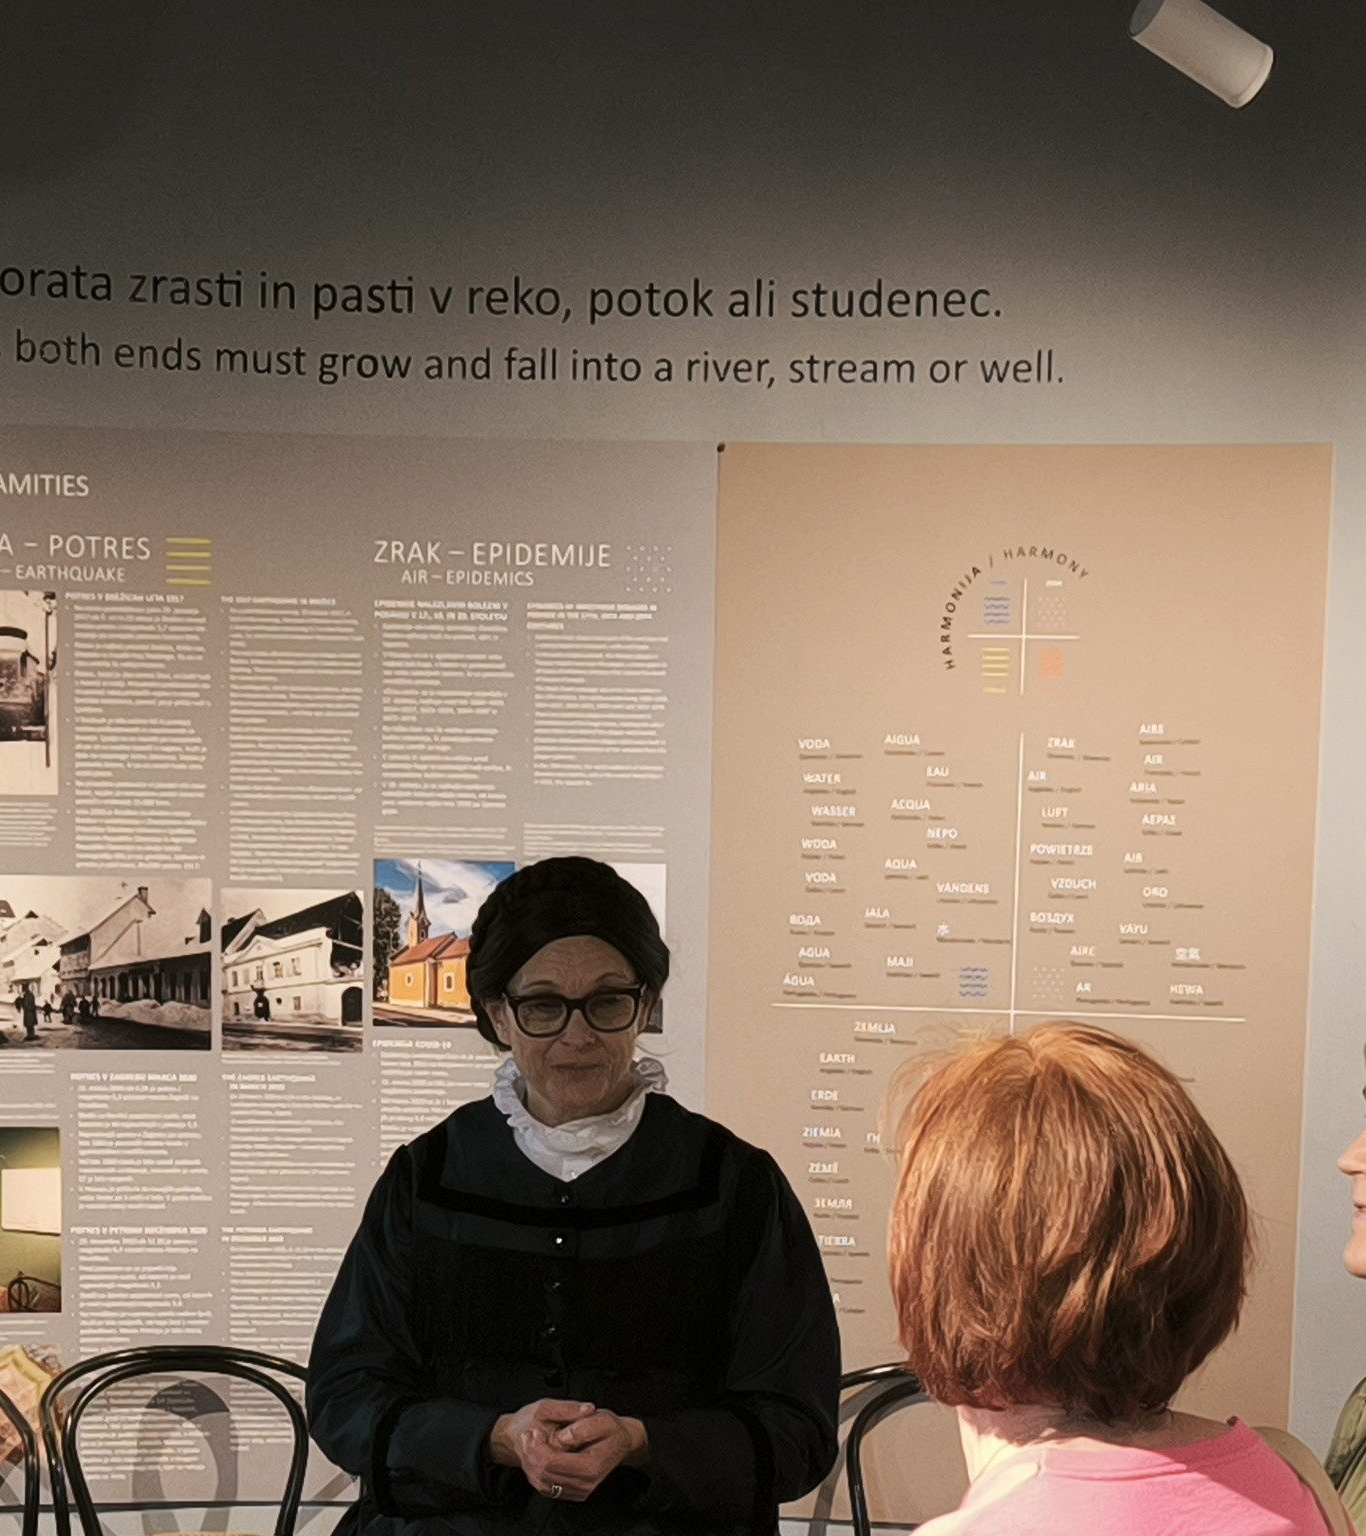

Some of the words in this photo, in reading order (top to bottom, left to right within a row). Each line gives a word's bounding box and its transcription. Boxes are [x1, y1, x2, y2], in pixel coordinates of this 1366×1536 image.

[128, 270, 242, 308] zrasti
[260, 271, 295, 310] in
[314, 275, 413, 321] pasti
[429, 286, 453, 314] v
[468, 275, 571, 323] reko,
[590, 277, 714, 326] potok
[728, 278, 775, 318] ali
[791, 278, 1001, 318] studenec.
[16, 328, 100, 366] both
[114, 337, 201, 371] ends
[216, 346, 307, 376] must
[318, 353, 412, 385] grow
[424, 347, 491, 380] and
[504, 346, 557, 381] fall
[572, 349, 642, 382] into
[654, 358, 673, 382] a
[687, 350, 775, 389] river,
[789, 354, 915, 384] stream
[929, 359, 968, 384] or
[980, 348, 1063, 384] well.
[49, 534, 151, 560] POTRES
[374, 540, 441, 564] ZRAK
[473, 542, 611, 568] EPIDEMIJE
[15, 564, 125, 583] EARTHQUAKE
[401, 569, 428, 584] AIR
[446, 570, 534, 586] EPIDEMICS
[940, 566, 981, 670] HARMONIJA
[1003, 545, 1089, 579] HARMONY
